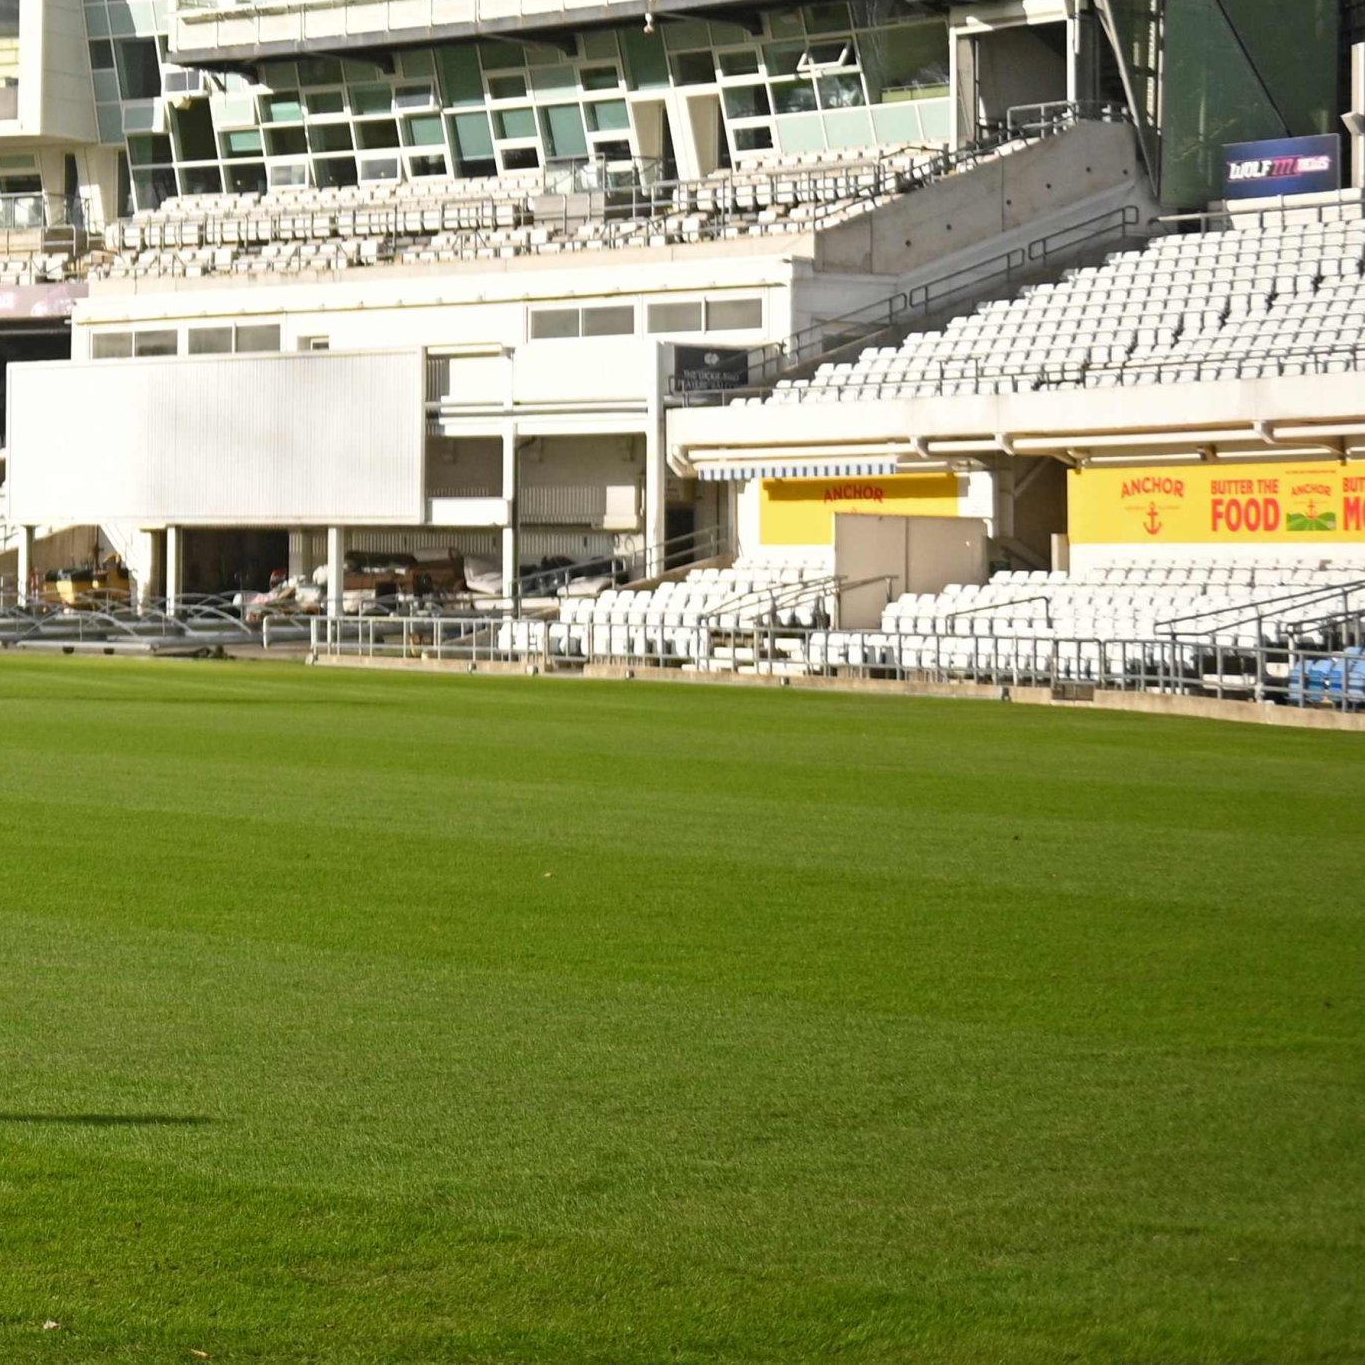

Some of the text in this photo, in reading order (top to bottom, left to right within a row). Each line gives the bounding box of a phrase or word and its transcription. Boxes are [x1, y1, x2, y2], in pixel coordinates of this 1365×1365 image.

[823, 485, 884, 503] ANCHOR
[1121, 476, 1184, 498] ANCHOR
[1211, 478, 1279, 495] BUTTER THE
[1211, 498, 1280, 532] FOOD
[1343, 496, 1365, 531] M
